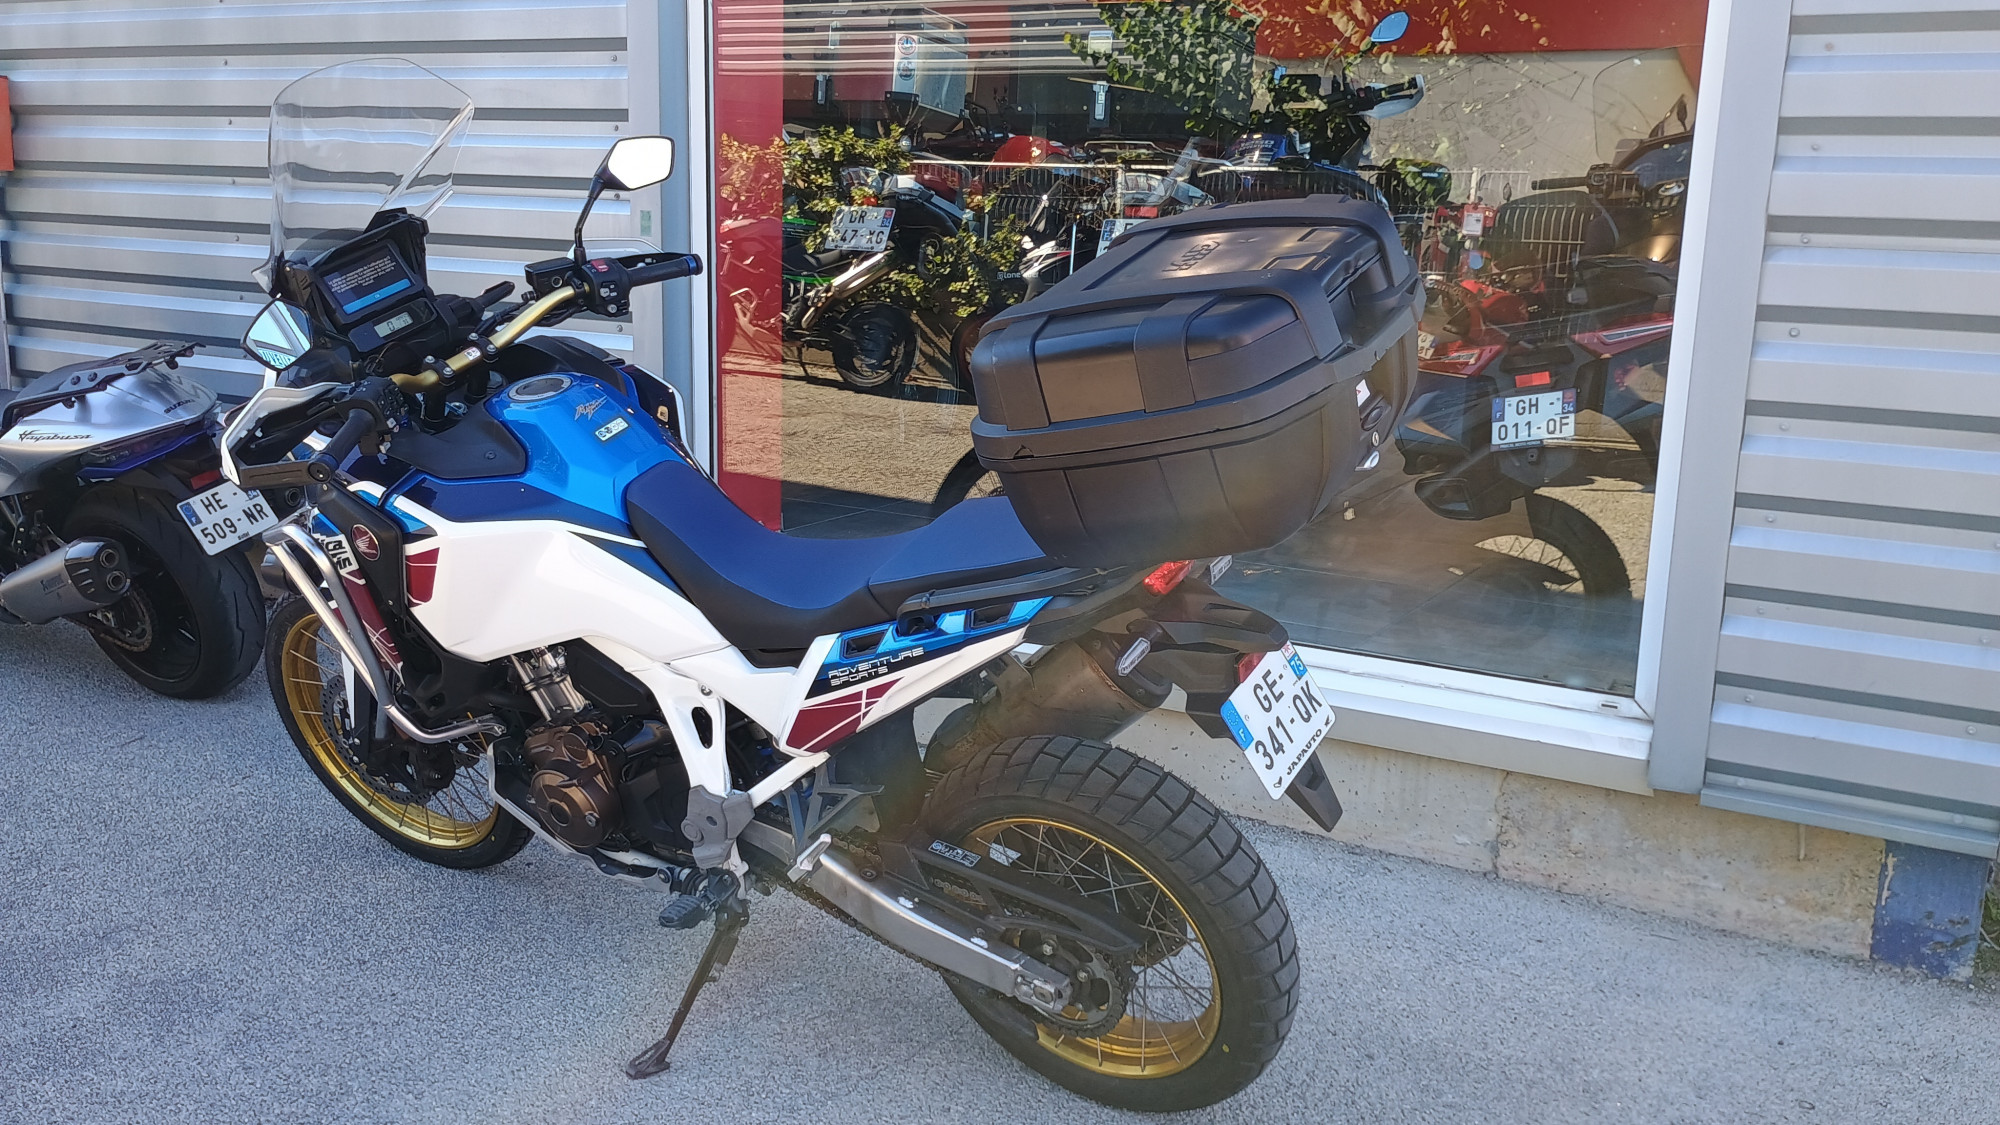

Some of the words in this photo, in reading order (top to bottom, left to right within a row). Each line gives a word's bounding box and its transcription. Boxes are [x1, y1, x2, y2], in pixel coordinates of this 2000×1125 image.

[1562, 403, 1574, 412] 34
[18, 429, 94, 442] Hayabusa
[200, 503, 269, 545] 509-NR
[828, 647, 925, 679] ADVENTURE
[1290, 655, 1304, 675] 75
[830, 665, 889, 687] SPORTS
[1238, 728, 1247, 742] F
[1254, 680, 1323, 771] 341-QK
[1286, 728, 1323, 776] JAPAUTO
